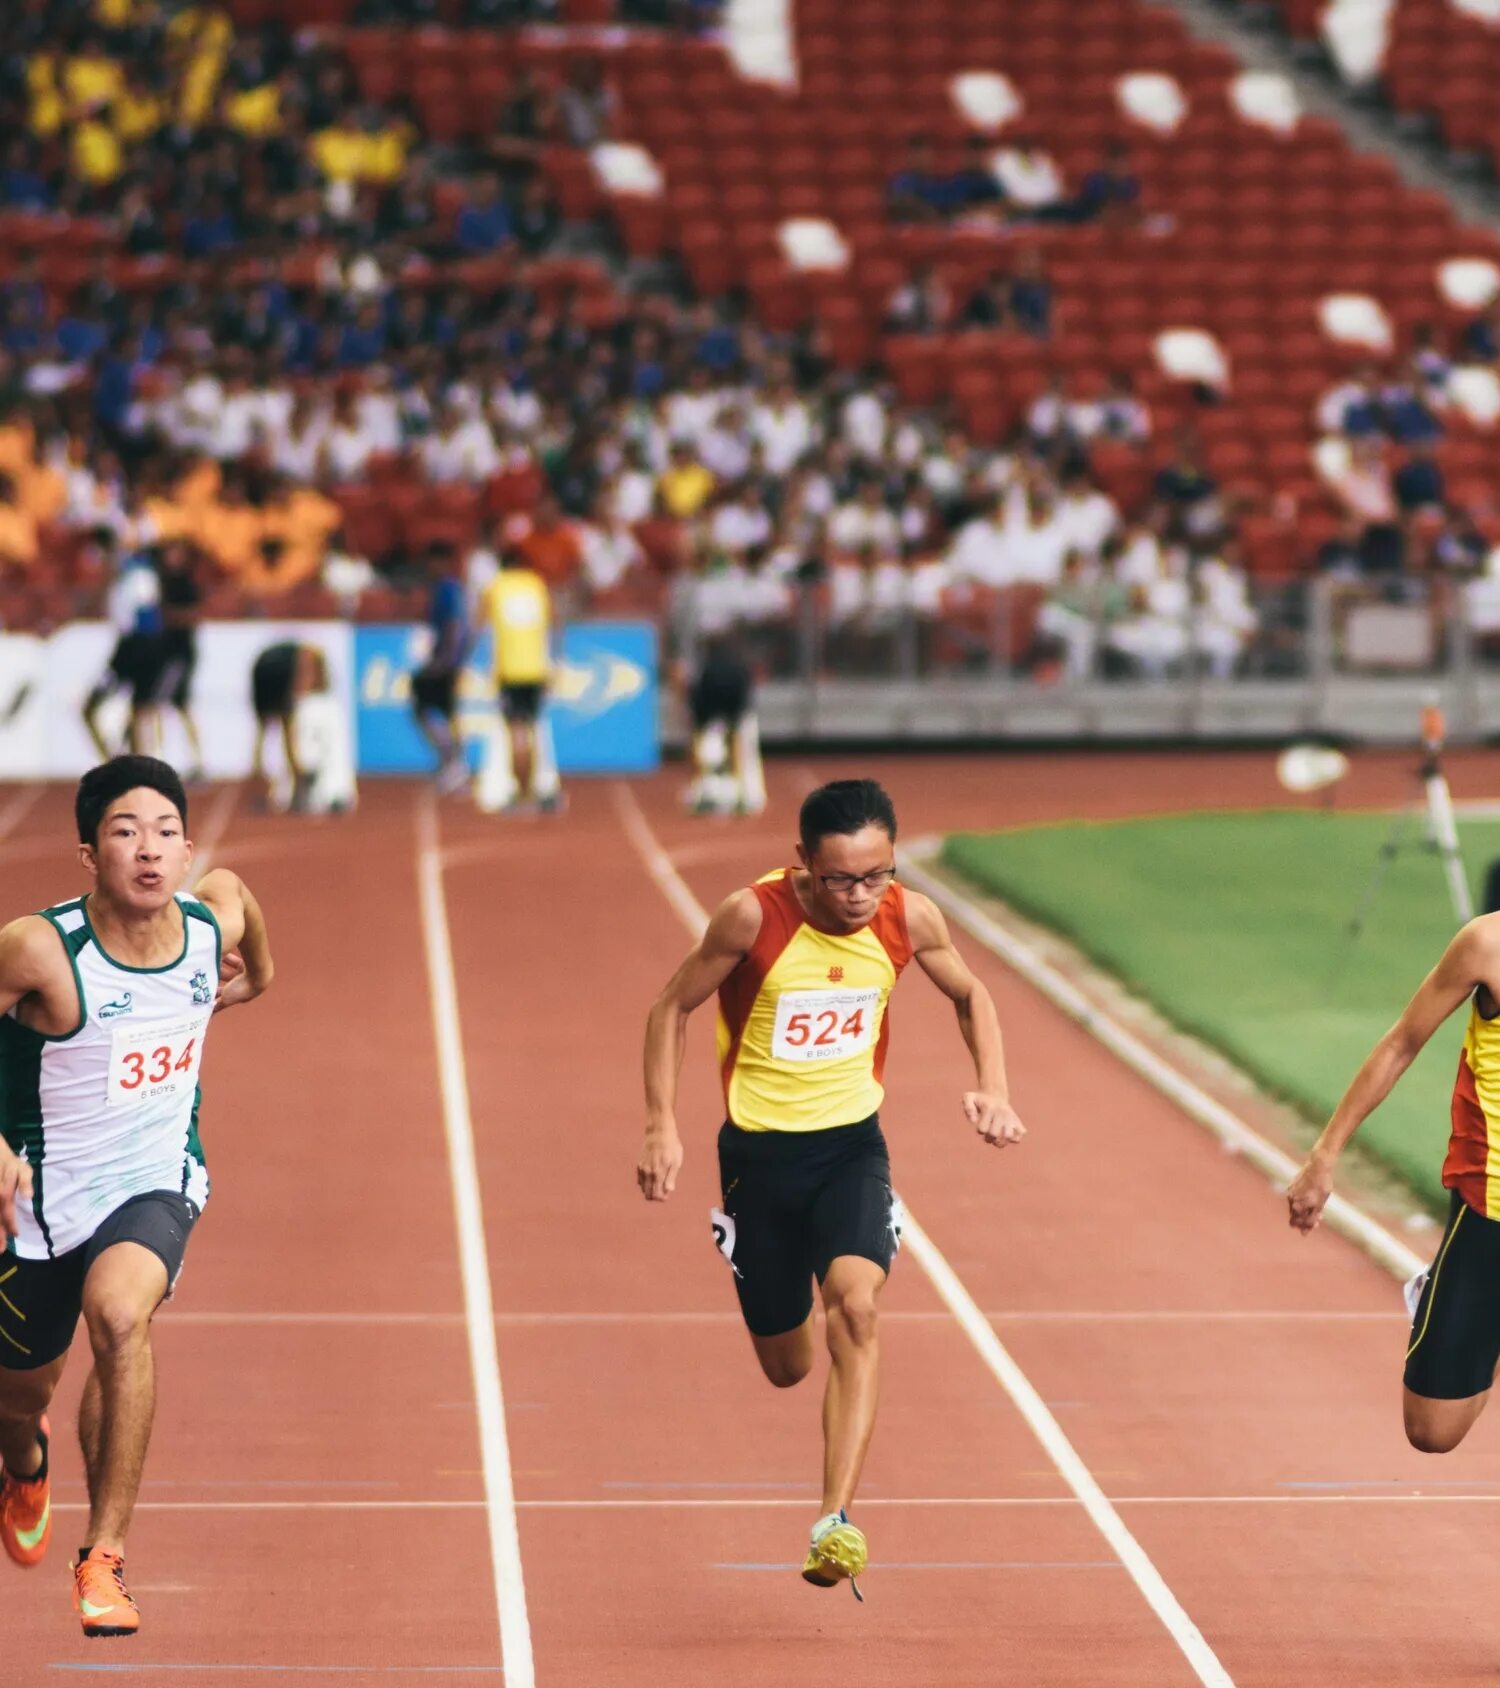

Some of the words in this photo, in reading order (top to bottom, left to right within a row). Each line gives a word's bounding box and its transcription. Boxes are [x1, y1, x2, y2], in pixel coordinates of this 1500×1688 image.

[785, 1008, 864, 1046] 524
[120, 1038, 195, 1089] 334
[817, 1047, 843, 1057] BOYS
[150, 1084, 176, 1096] BOYS
